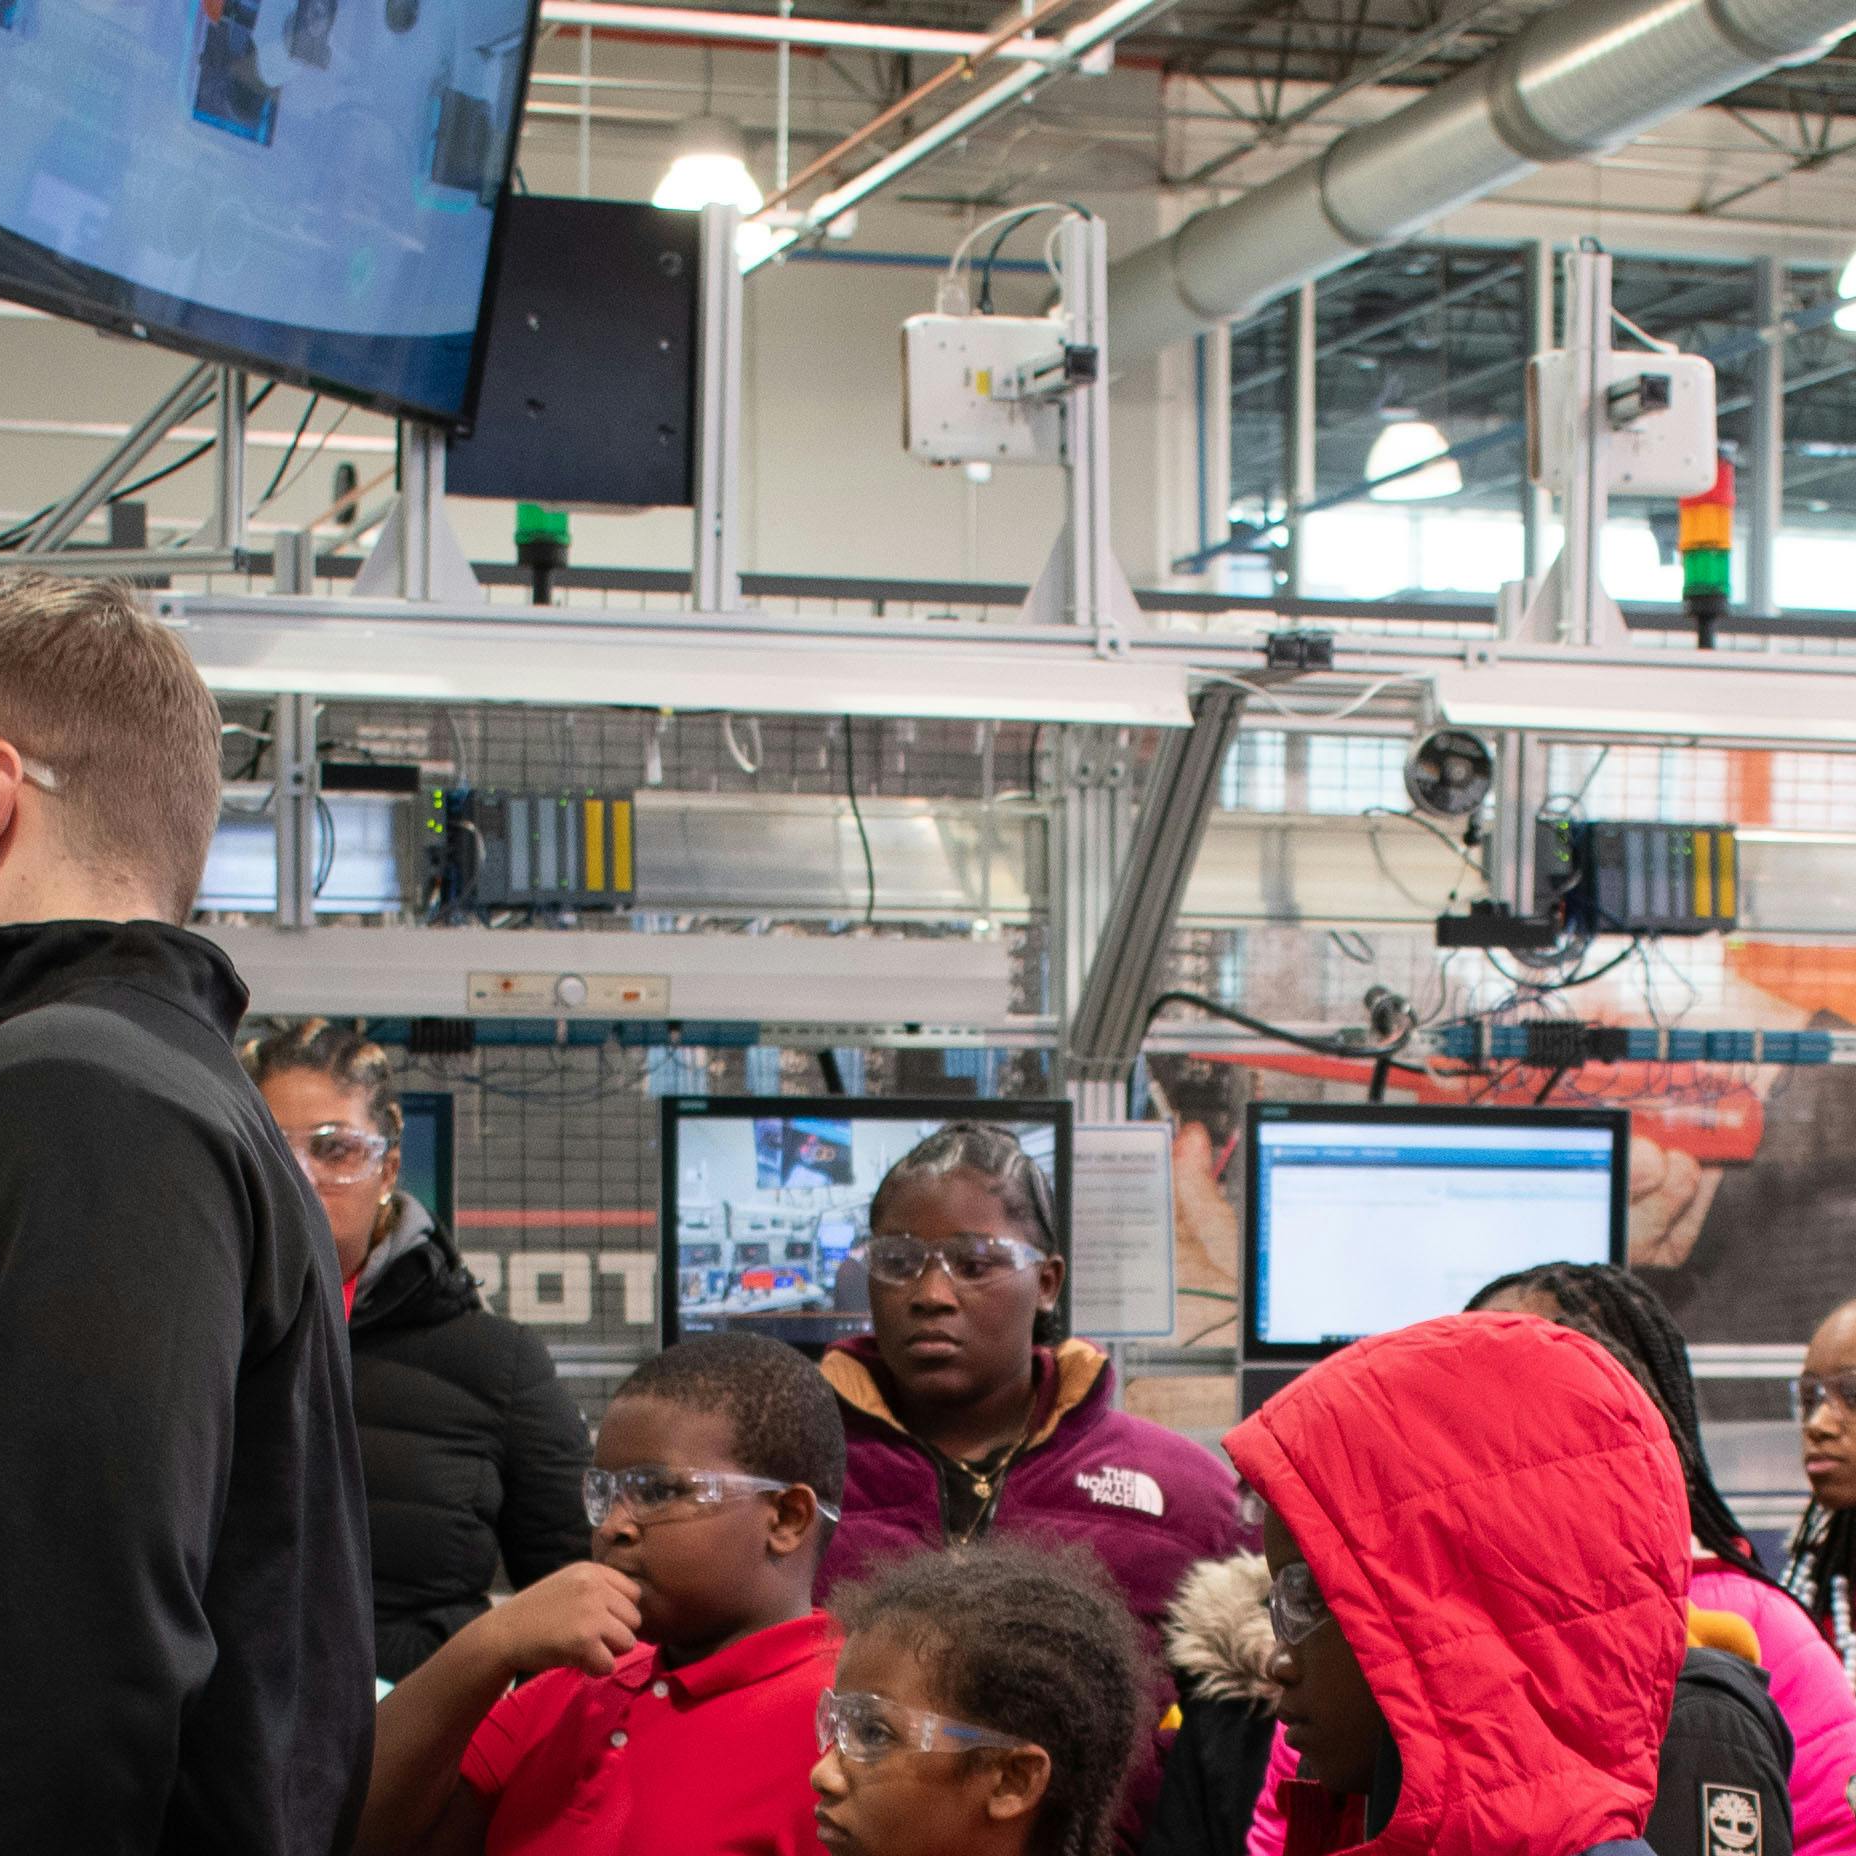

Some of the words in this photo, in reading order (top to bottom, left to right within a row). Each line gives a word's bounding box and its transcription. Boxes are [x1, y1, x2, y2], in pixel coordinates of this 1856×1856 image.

[1101, 1464, 1136, 1482] THE
[1075, 1471, 1136, 1496] NORTH
[1091, 1489, 1136, 1509] FACE
